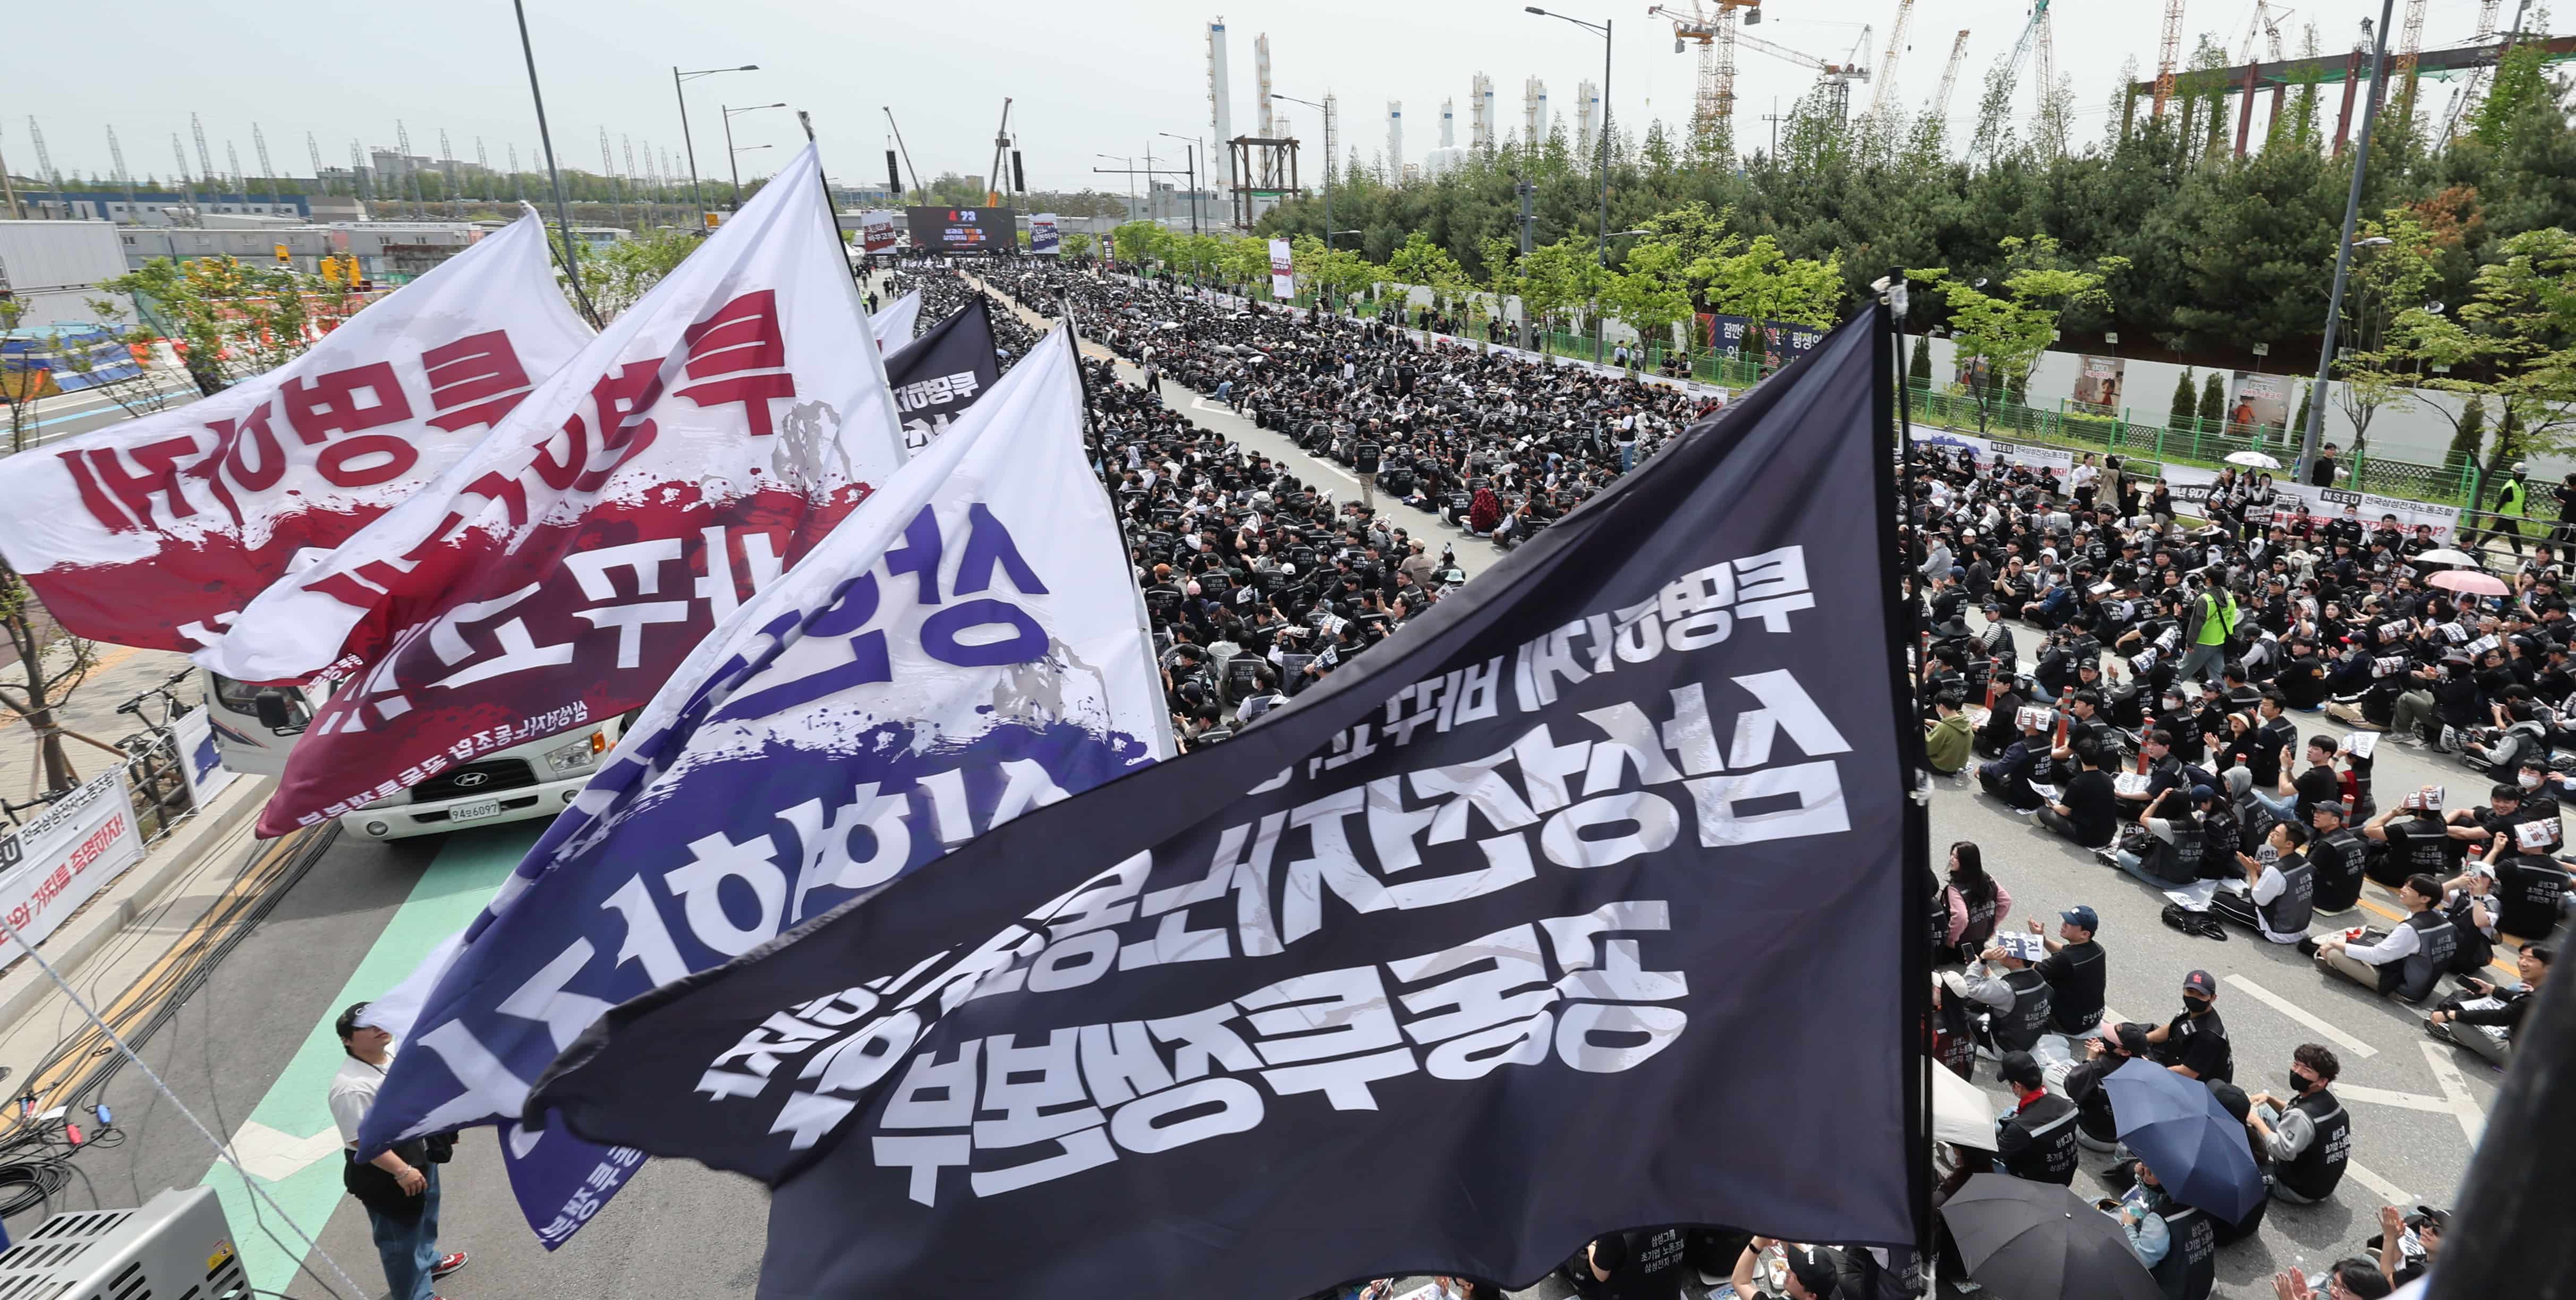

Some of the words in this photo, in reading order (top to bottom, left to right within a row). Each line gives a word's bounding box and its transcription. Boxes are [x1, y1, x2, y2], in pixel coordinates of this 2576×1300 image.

[1992, 444, 2013, 454] NSEU
[2015, 446, 2070, 459] 전국삼성전자노동조합
[2323, 491, 2360, 505] NSEU
[2364, 496, 2454, 517] 전국삼성전자노동조합
[21, 773, 114, 845] 전국삼성전자노동조합
[31, 862, 71, 916] 가치를
[69, 812, 126, 876] 증명하자!
[1651, 1228, 1676, 1247] 삼성그룹
[1640, 1250, 1661, 1262] 초기업
[1663, 1238, 1685, 1255] 노동조합
[1644, 1258, 1670, 1273] 삼성전자
[1672, 1251, 1684, 1264] 지부
